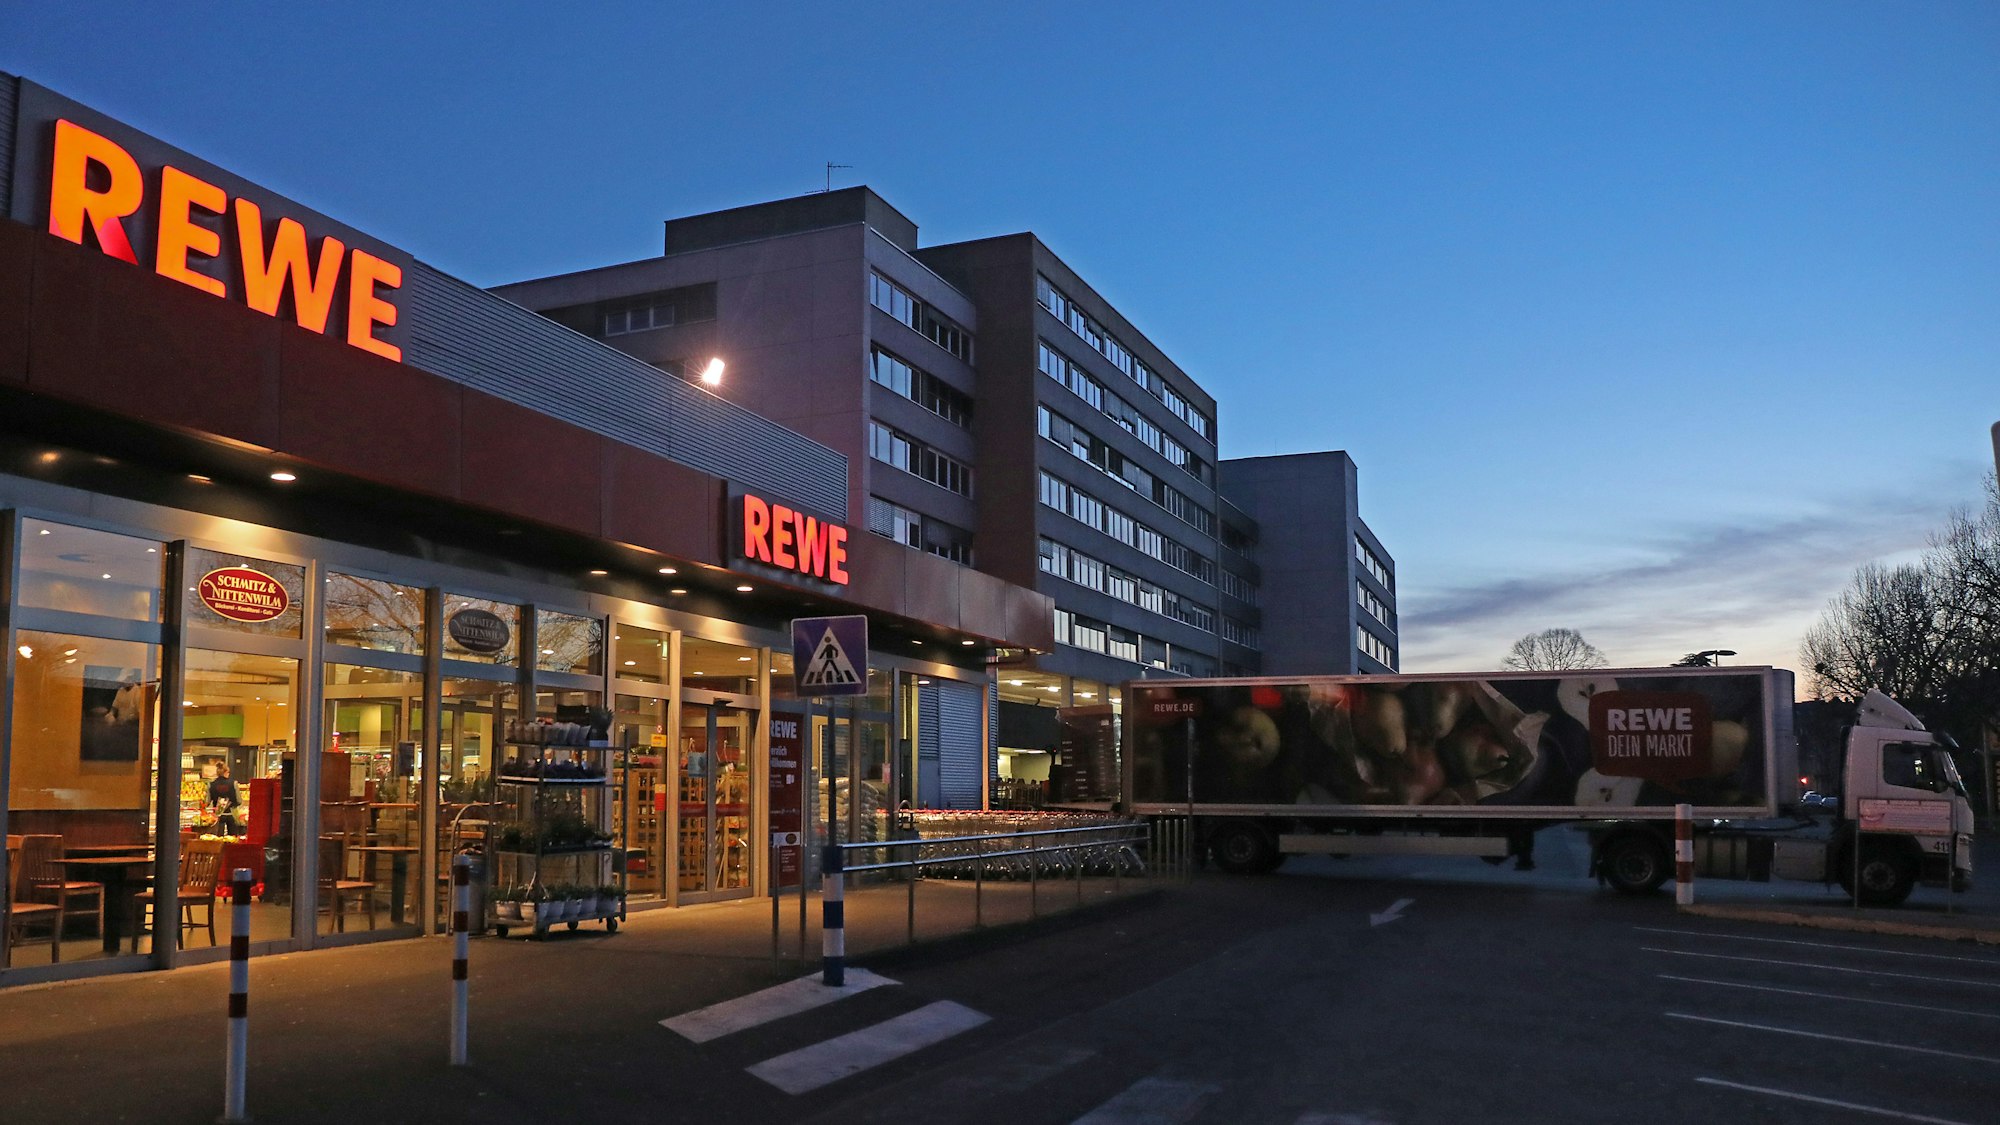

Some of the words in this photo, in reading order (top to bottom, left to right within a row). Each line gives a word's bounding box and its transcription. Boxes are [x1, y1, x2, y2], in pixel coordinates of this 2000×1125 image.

[49, 118, 402, 363] REWE
[744, 493, 849, 585] REWE
[202, 579, 282, 607] NITTENWILM
[218, 575, 267, 592] SCHMITZ
[267, 582, 277, 594] &
[1154, 703, 1194, 712] REWE.DE
[1607, 708, 1693, 731] REWE
[1608, 734, 1641, 757] DEIN
[1646, 733, 1693, 757] MARKT
